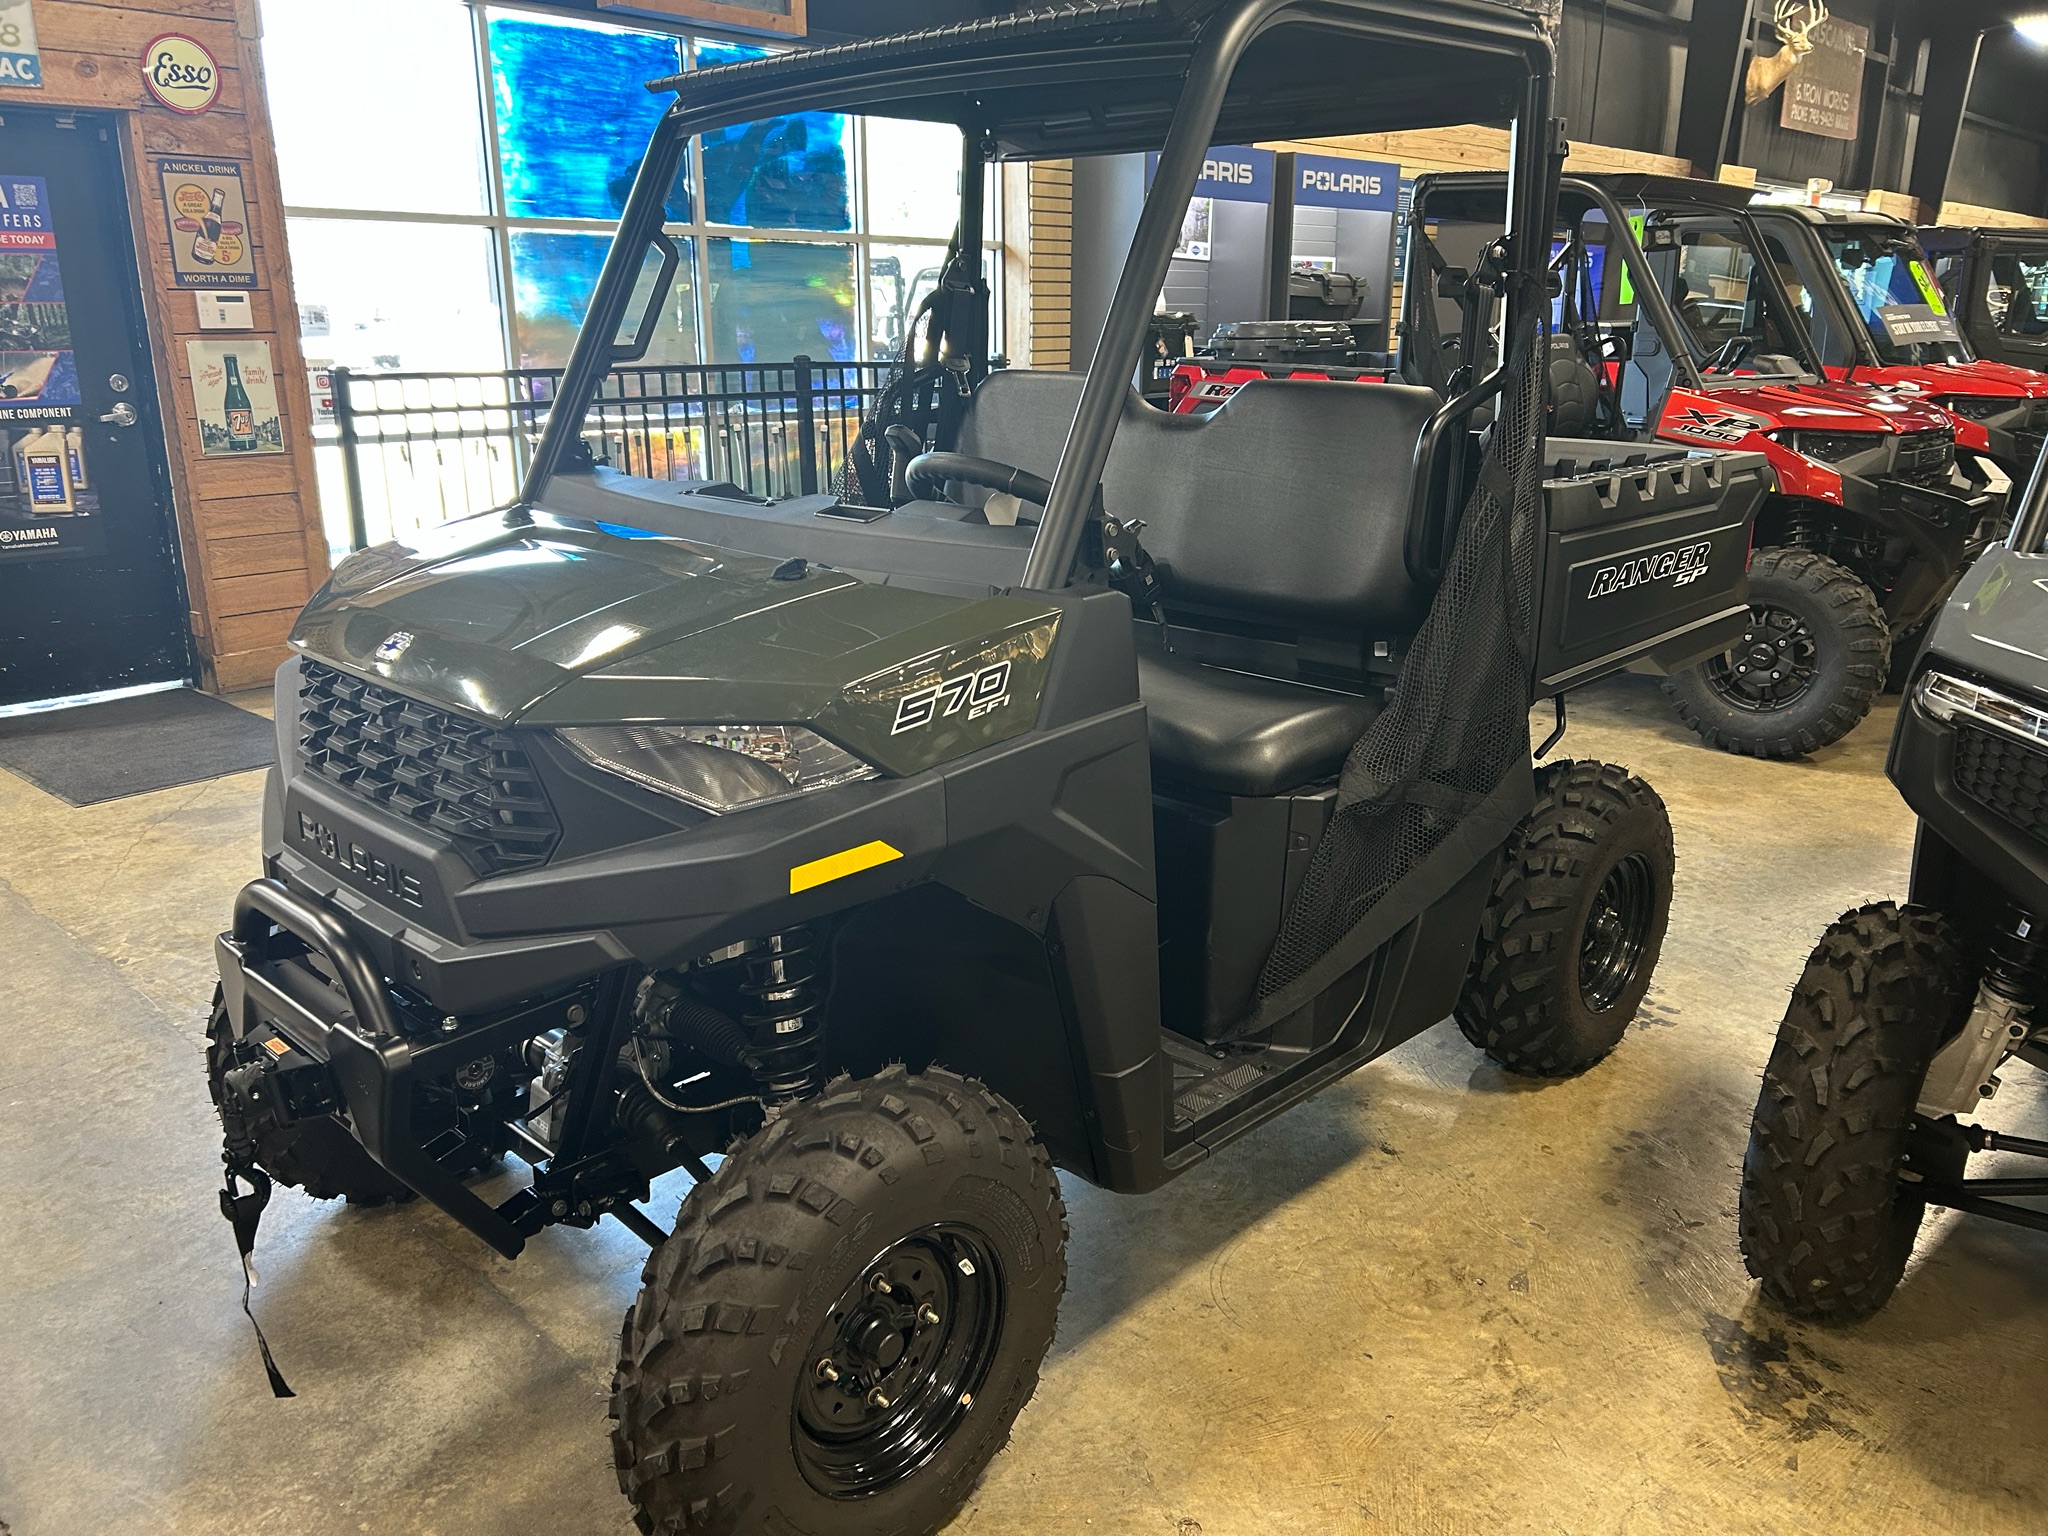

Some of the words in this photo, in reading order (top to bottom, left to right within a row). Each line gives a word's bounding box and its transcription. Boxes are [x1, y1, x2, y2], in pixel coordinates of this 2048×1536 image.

[153, 51, 211, 88] Esso
[1802, 82, 1822, 106] IRON
[1823, 88, 1850, 112] WORKS
[1790, 103, 1809, 122] PHONE
[163, 162, 171, 171] A
[172, 163, 207, 173] NICKEL
[208, 165, 237, 175] DRINK
[1302, 169, 1382, 195] POLARIS
[9, 234, 45, 245] TODAY
[183, 274, 219, 283] WORTH
[220, 275, 228, 283] A
[228, 275, 252, 283] DIME
[242, 365, 266, 377] family
[245, 375, 268, 385] drink!
[16, 406, 72, 419] COMPONENT
[1665, 406, 1762, 432] XP
[1680, 423, 1745, 443] 1000
[11, 527, 58, 541] YAMAHA
[1587, 541, 1712, 600] RANGER
[1672, 565, 1709, 588] SP
[891, 660, 1012, 736] 570
[967, 694, 1011, 721] EFI
[298, 810, 424, 908] POLARIS
